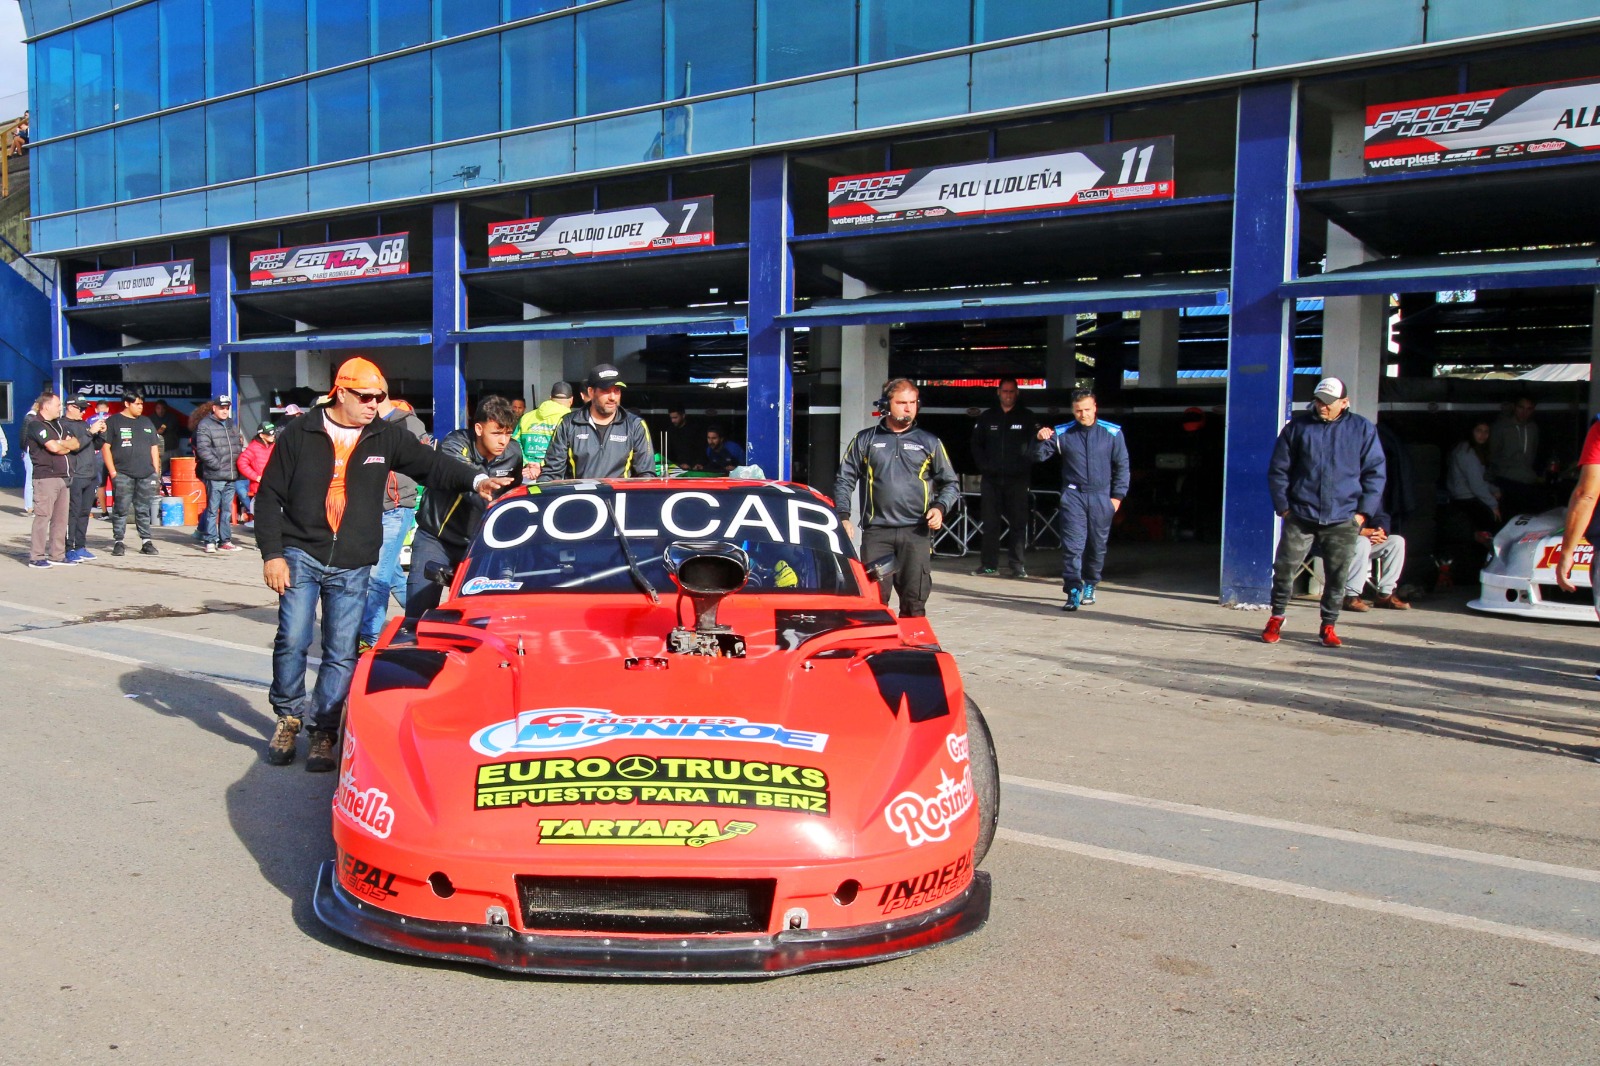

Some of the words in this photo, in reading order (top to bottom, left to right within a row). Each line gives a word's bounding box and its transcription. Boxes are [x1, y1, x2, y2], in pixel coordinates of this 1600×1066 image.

[1373, 99, 1495, 128] PROCAR
[1397, 119, 1462, 137] 4000
[1117, 145, 1155, 185] 11
[1368, 152, 1441, 168] waterplast
[833, 175, 906, 194] PROCAR
[938, 181, 980, 202] FACU
[984, 169, 1063, 196] LUDUEÑA
[847, 189, 886, 202] 4000
[1077, 190, 1109, 200] AGAIN
[678, 203, 699, 234] 7
[831, 214, 875, 225] waterplast
[492, 222, 541, 237] PROCAR
[558, 227, 605, 245] CLAUDIO
[607, 222, 645, 240] LOPEZ
[652, 237, 673, 246] AGAIN
[296, 248, 360, 269] ZAIRA
[378, 238, 405, 266] 68
[490, 253, 521, 263] waterplast
[117, 279, 132, 291] NICO
[132, 276, 155, 289] BIONDO
[171, 263, 192, 287] 24
[144, 384, 193, 396] Willard
[482, 491, 844, 555] COLCAR
[469, 583, 520, 591] MONROE
[529, 713, 738, 727] CRISTALES
[519, 722, 818, 748] MONROE
[478, 758, 611, 785] EURO
[660, 758, 827, 788] TRUCKS
[477, 787, 633, 807] REPUESTOS
[642, 789, 709, 804] PARA
[719, 789, 747, 805] M.
[755, 791, 827, 814] BENZ
[538, 819, 723, 838] TARTARA
